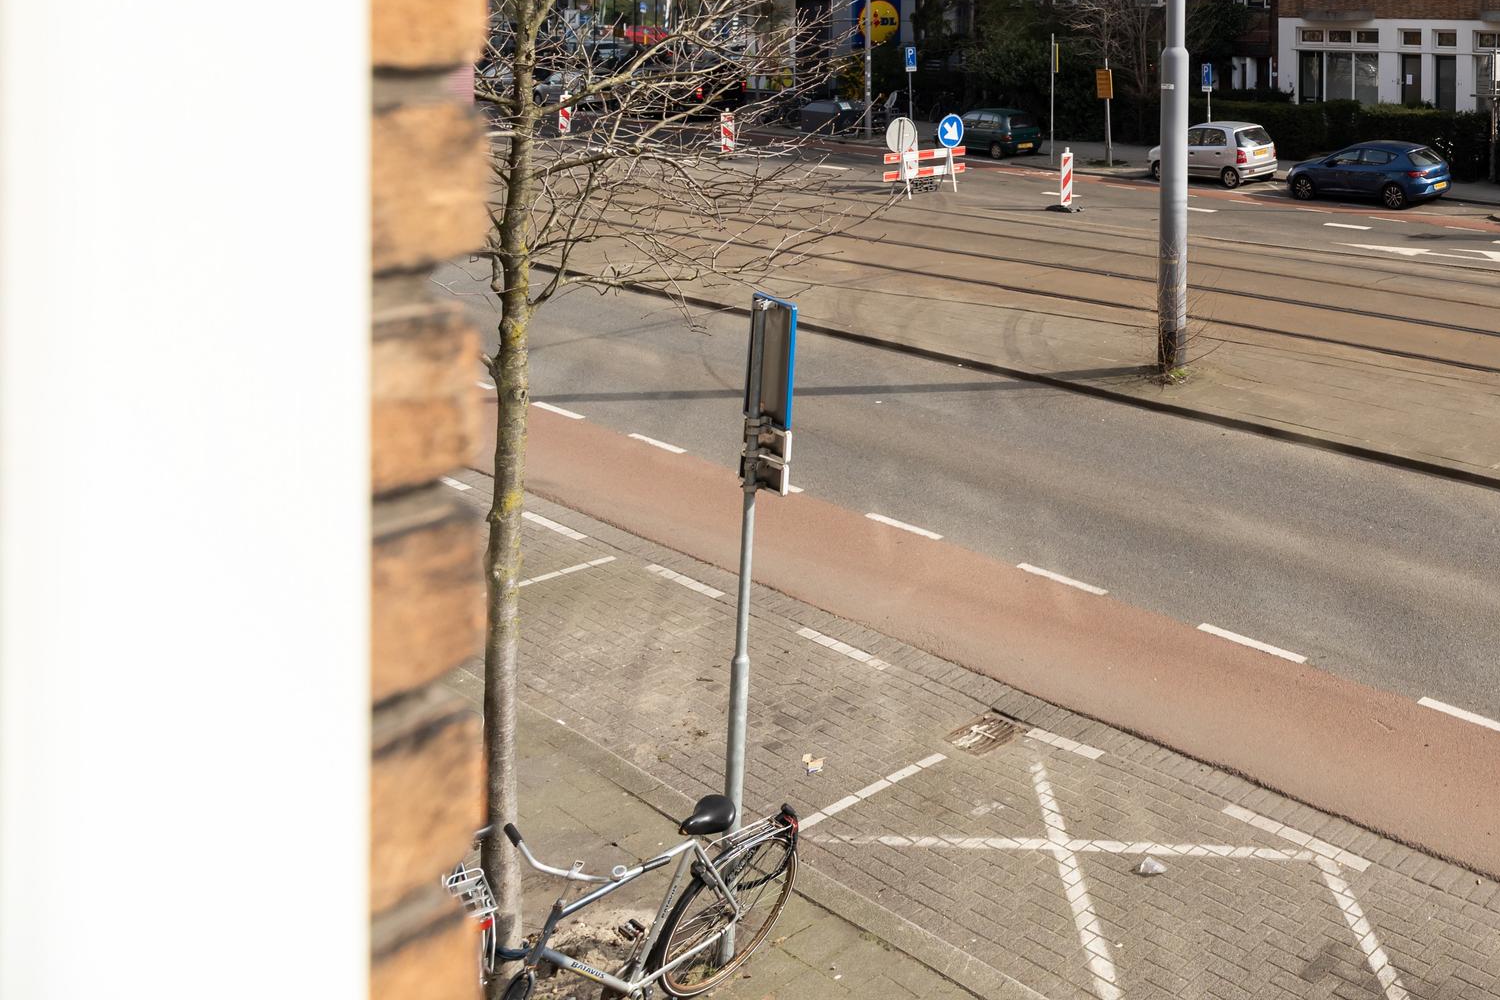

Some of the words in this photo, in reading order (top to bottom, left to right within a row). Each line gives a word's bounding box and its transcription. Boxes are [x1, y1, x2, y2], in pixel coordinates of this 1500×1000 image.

[908, 48, 914, 59] P
[1203, 65, 1209, 77] P
[571, 961, 606, 979] BATAVUS
